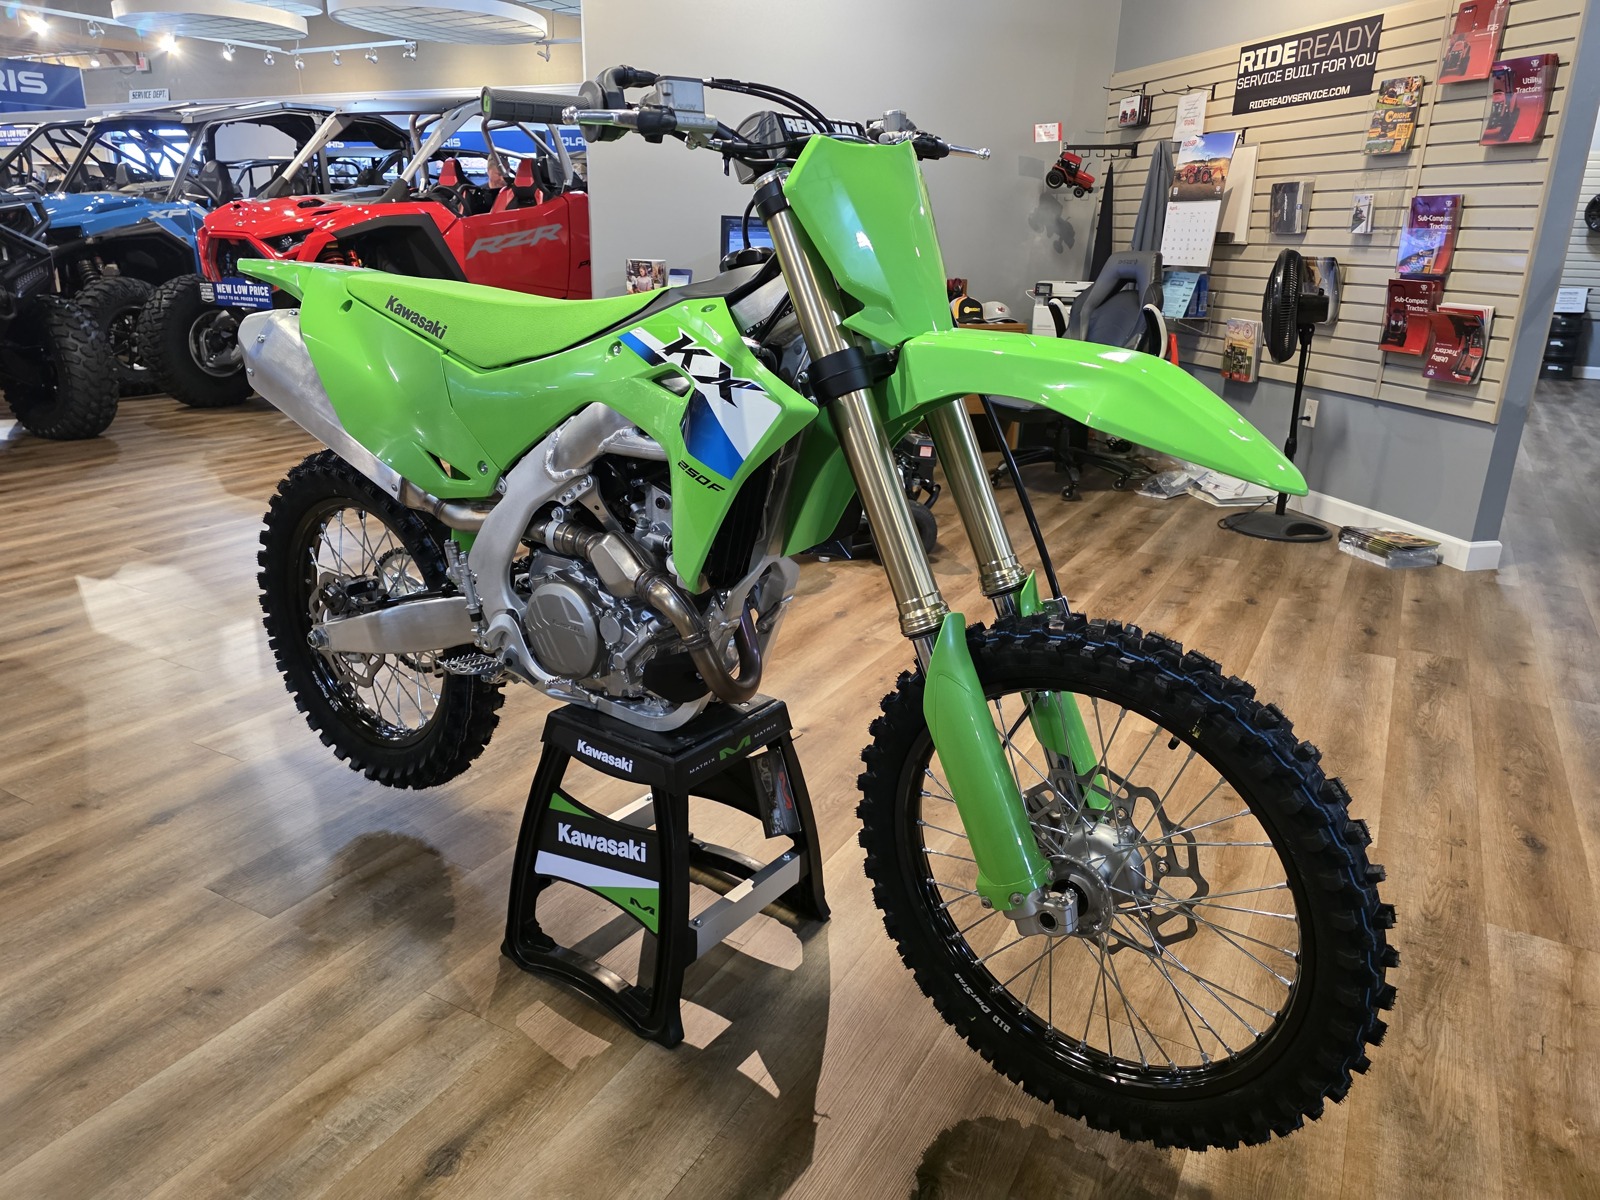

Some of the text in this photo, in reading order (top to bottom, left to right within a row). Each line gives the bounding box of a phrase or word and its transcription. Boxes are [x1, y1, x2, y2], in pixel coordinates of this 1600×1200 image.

[1237, 51, 1377, 90] SERVICE BUILT FOR YOU
[1522, 76, 1542, 85] Utility
[132, 91, 152, 99] SERVICE
[1248, 85, 1351, 110] RIDEREADYSERVICE.COM
[1516, 86, 1541, 94] Tractors
[147, 208, 188, 219] XP
[465, 223, 563, 260] RZR
[216, 283, 232, 294] NEW
[233, 284, 248, 295] LOW
[249, 285, 270, 297] PRICE
[1394, 295, 1429, 305] Sub-Compact
[385, 295, 448, 340] Kawasaki
[1406, 304, 1429, 312] Tractors
[661, 331, 766, 409] KX
[677, 459, 726, 492] 250F
[577, 739, 633, 773] Kawasaki
[689, 757, 716, 774] MATRIX
[754, 723, 777, 738] MATRIX
[557, 822, 647, 863] Kawasaki
